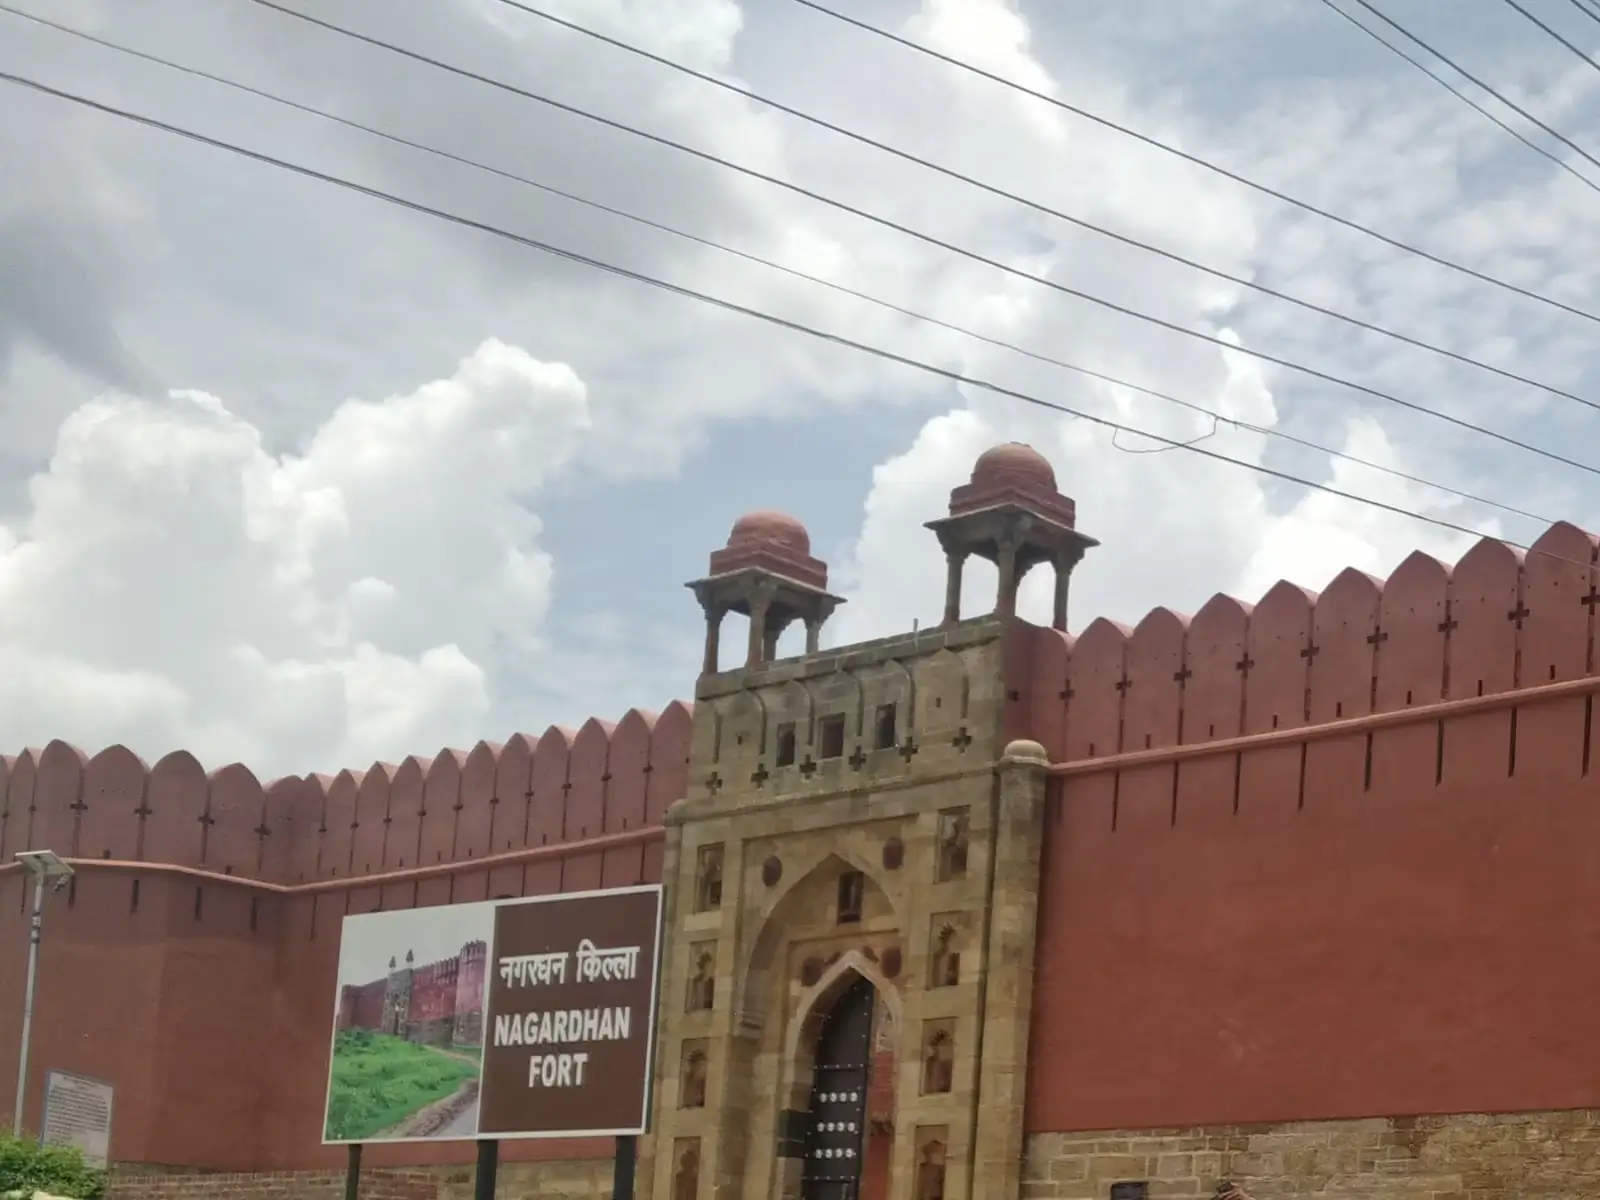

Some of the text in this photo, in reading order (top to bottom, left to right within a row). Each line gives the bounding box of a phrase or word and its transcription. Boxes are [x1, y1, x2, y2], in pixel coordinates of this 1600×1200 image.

[576, 938, 641, 983] किल्ला
[494, 1007, 631, 1046] NAGARDHAN
[528, 1053, 588, 1088] FORT
